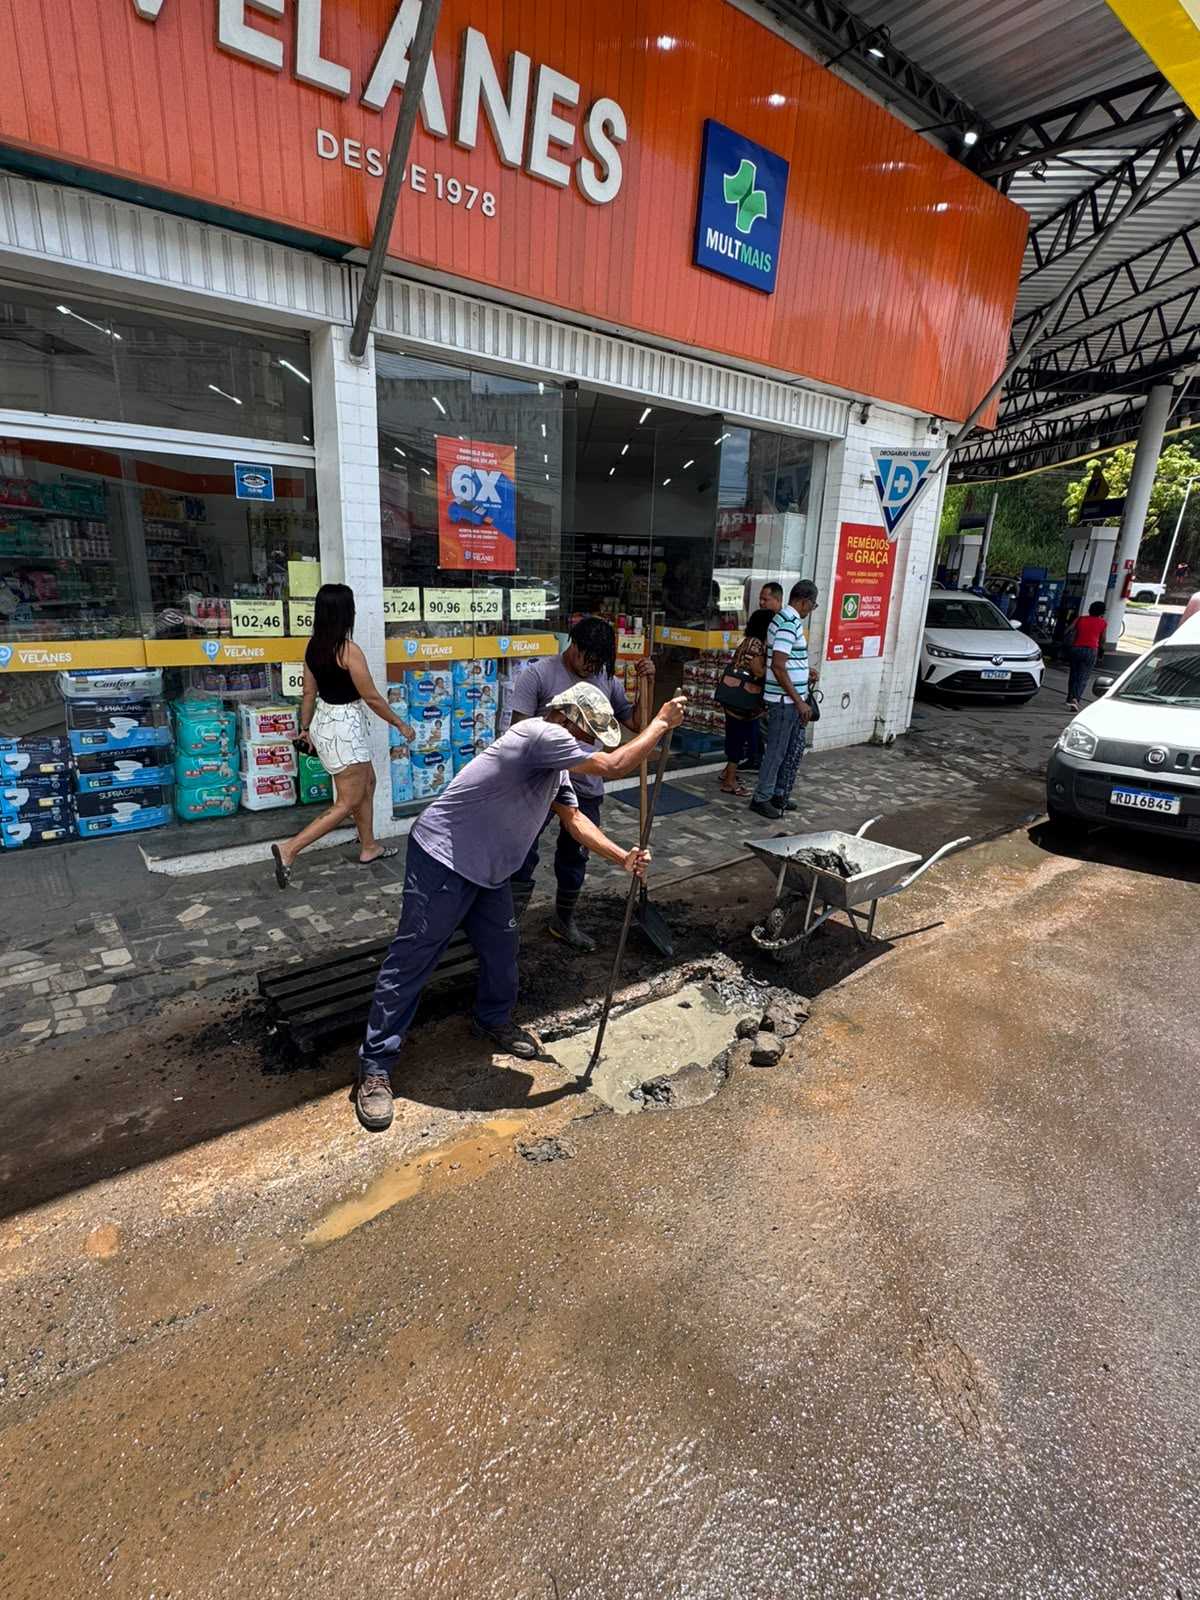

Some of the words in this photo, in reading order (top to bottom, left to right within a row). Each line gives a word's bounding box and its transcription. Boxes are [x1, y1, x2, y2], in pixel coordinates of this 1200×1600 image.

[133, 0, 627, 204] ELANES
[316, 127, 428, 193] DESE
[434, 172, 496, 217] 1978
[705, 227, 772, 272] MULTMAIS
[451, 465, 502, 504] 6X
[848, 534, 890, 550] REMÉDIOS
[846, 552, 854, 560] DE
[854, 550, 889, 568] GRAÇA
[429, 601, 460, 614] 90,96
[470, 602, 498, 613] 65,29
[233, 615, 280, 629] 102,46
[224, 647, 265, 657] VELANES
[622, 642, 642, 650] 44,77
[19, 652, 72, 664] VELANES
[1115, 792, 1172, 811] RDI6B45
